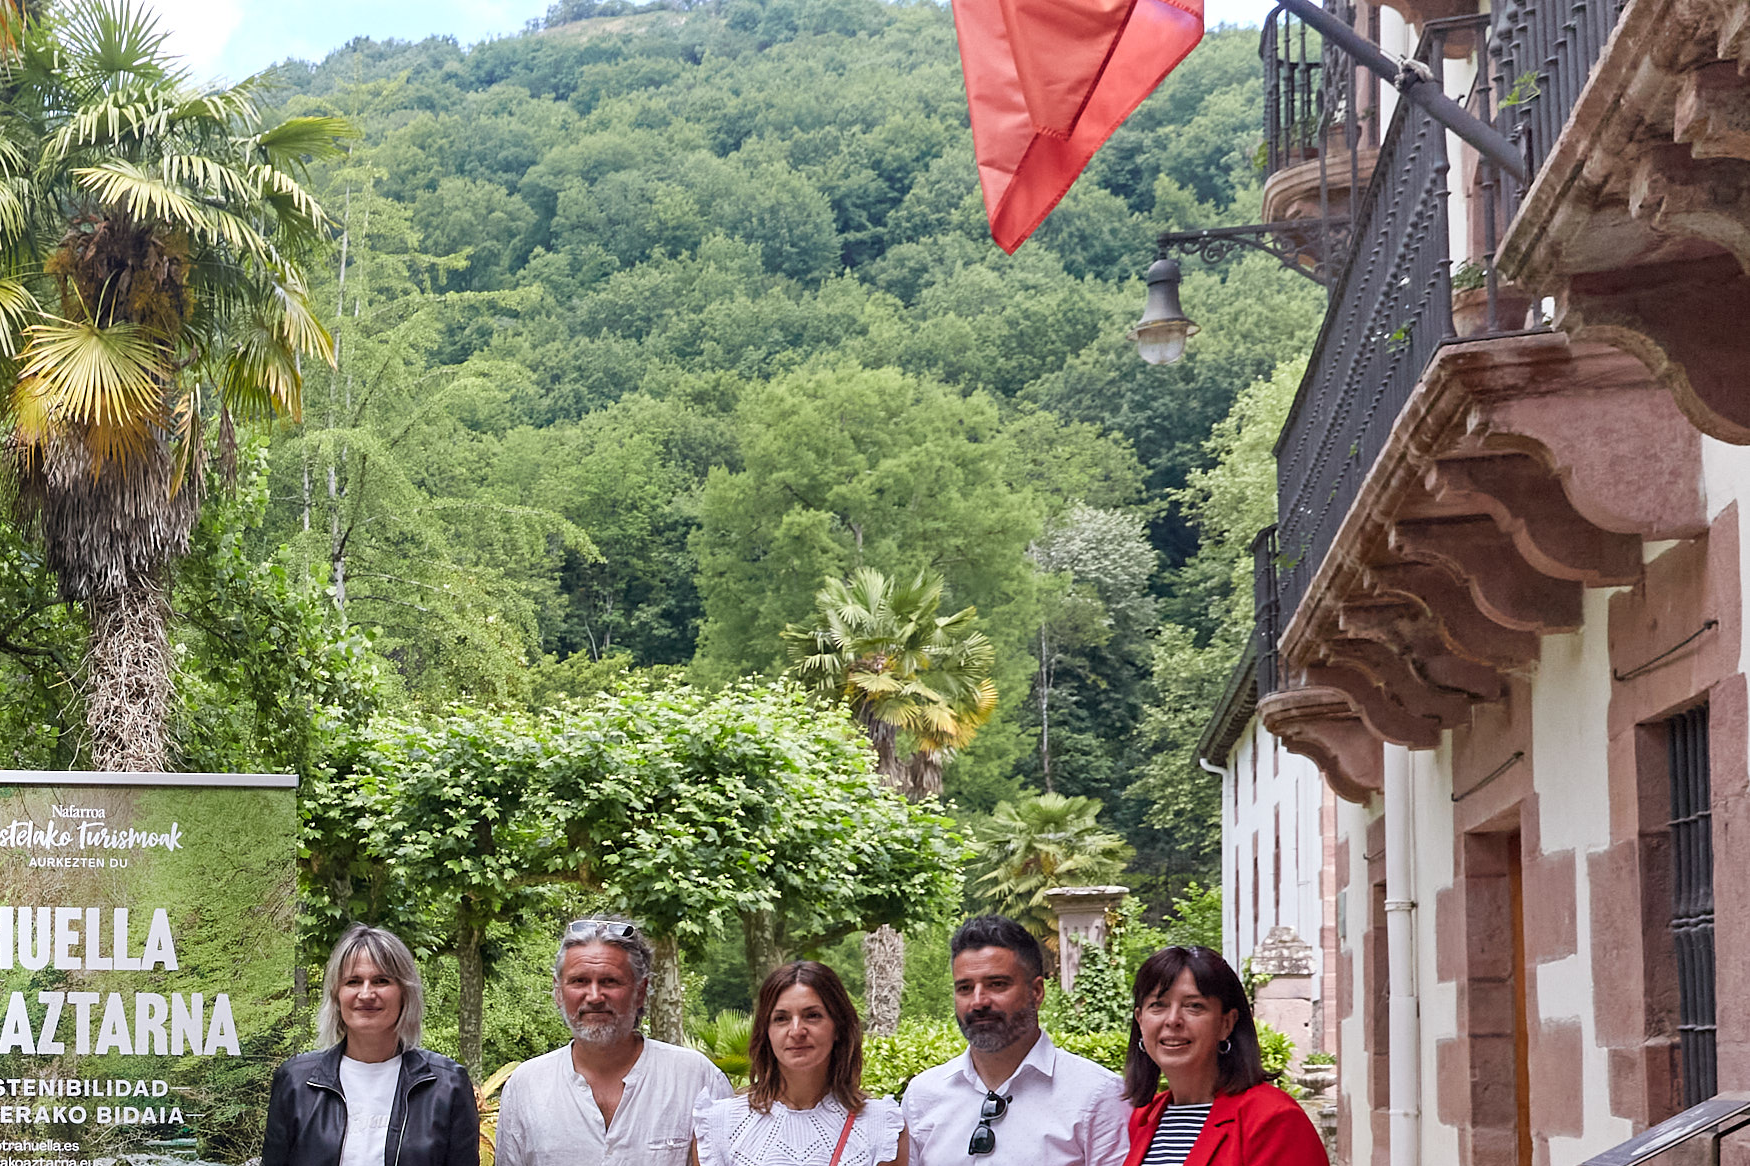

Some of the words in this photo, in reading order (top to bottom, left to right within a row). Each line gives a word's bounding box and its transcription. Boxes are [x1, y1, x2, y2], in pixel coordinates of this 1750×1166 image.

[51, 804, 106, 819] Nafarroa
[28, 857, 105, 868] AURKEZTEN
[109, 858, 128, 868] DU
[96, 1106, 185, 1124] BIDAIA
